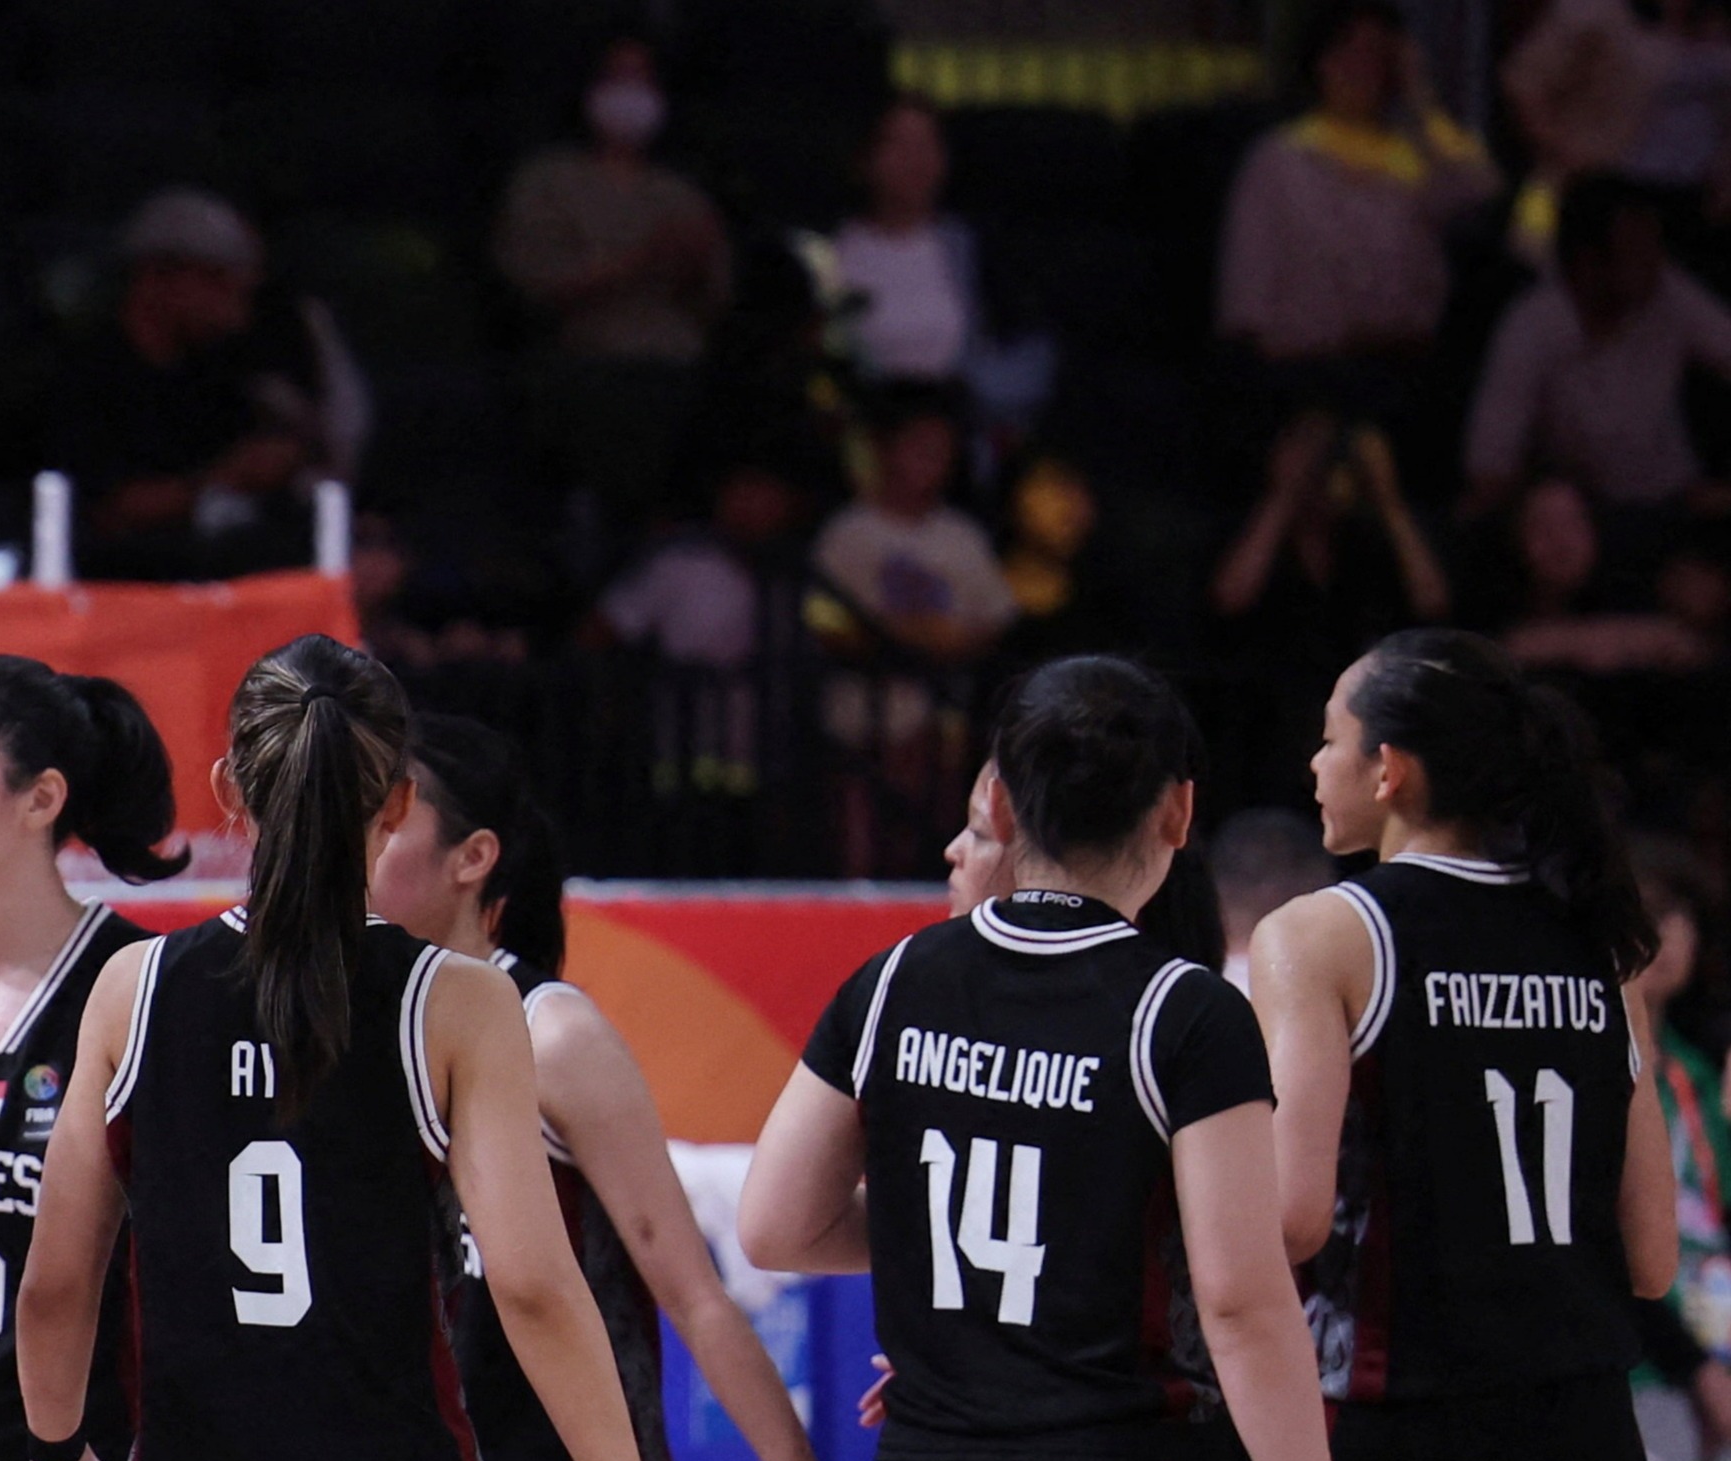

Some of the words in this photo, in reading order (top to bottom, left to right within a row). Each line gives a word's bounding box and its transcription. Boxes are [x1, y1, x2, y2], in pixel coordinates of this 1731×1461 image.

[1042, 891, 1083, 908] PRO
[1424, 970, 1607, 1034] FAIZZATUS
[230, 1040, 276, 1098] AY
[896, 1027, 1100, 1113] ANGELIQUE
[1484, 1068, 1574, 1246] 11
[228, 1140, 313, 1327] 9
[919, 1128, 1046, 1327] 14
